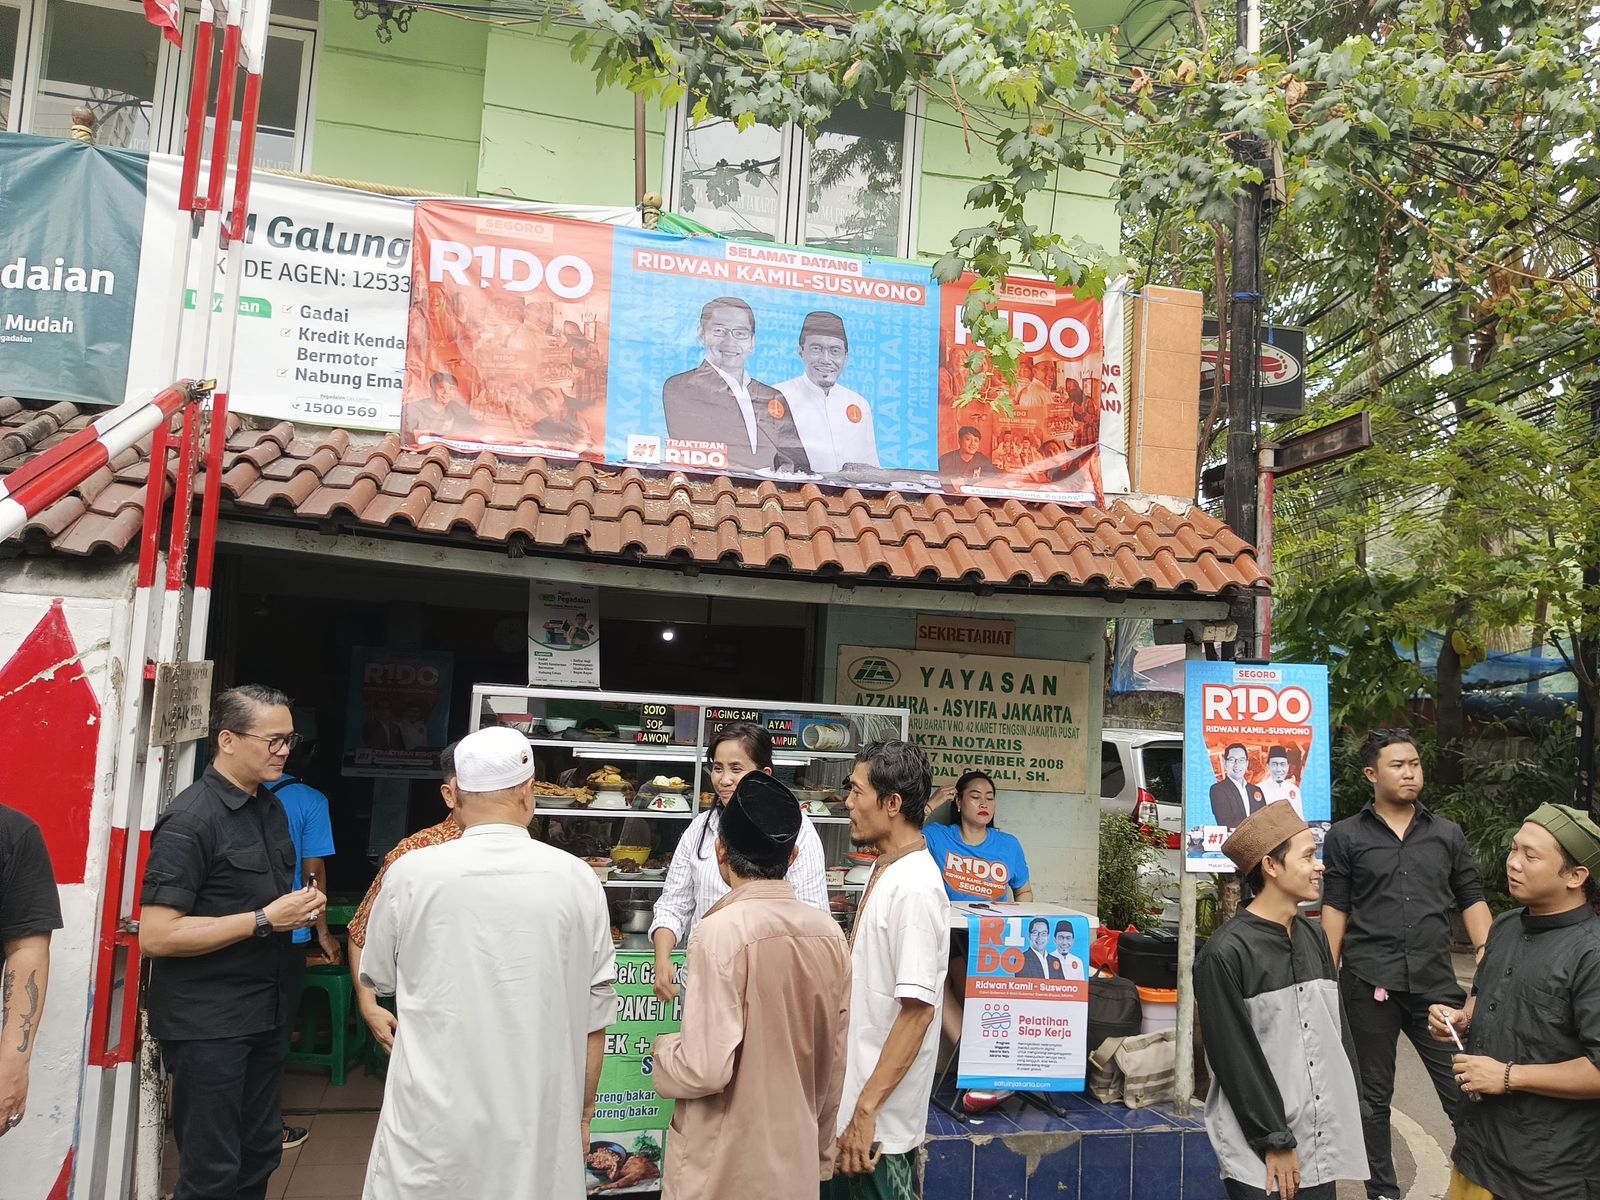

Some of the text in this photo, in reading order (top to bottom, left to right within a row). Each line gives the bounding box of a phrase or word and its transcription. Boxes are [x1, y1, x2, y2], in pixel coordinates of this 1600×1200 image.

[485, 218, 545, 235] SEGORO
[266, 215, 411, 269] Galung
[728, 245, 858, 273] SELAMAT DATANG
[1, 257, 115, 295] daian
[215, 257, 411, 293] KDE AGEN: 12533
[637, 251, 730, 278] RIDWAN
[736, 265, 922, 302] KAMIL-SUSWONO
[300, 304, 350, 323] Gadai
[5, 313, 74, 333] Mudah
[299, 326, 405, 350] Kredit Kenda
[297, 346, 379, 367] Bermotor
[295, 367, 403, 390] Nabung Ema
[304, 402, 378, 418] 1500 569
[633, 443, 657, 457] #1
[665, 439, 725, 450] TRAKTIRAN
[919, 624, 1013, 646] SEKRETARIAT
[919, 666, 1058, 696] YAYASAN
[1238, 670, 1276, 679] SEGORO
[643, 705, 666, 716] SOTO
[706, 708, 758, 721] DAGING SAPI
[942, 698, 997, 719] ASYIFA
[1002, 702, 1073, 724] JAKARTA
[646, 719, 662, 730] SOP
[714, 723, 725, 734] IG
[768, 720, 793, 730] AYAM
[908, 717, 922, 730] ARU
[924, 719, 947, 731] BARAT
[953, 721, 965, 732] NO.
[965, 721, 974, 732] 42
[975, 722, 998, 734] KARET
[999, 723, 1027, 736] TENGSIN
[1028, 725, 1057, 738] JAKARTA
[1059, 726, 1080, 739] PUSAT
[1205, 725, 1310, 736] RIDWAN KAMIL-SUSWONO
[636, 733, 669, 744] RAWON
[771, 735, 797, 746] AMPUR
[952, 736, 1022, 750] NOTARIS
[943, 753, 1025, 767] NOVEMBER
[1030, 758, 1064, 769] 2008
[932, 766, 1050, 783] DAL GZALI, SH.
[1208, 834, 1224, 844] #1
[959, 881, 993, 895] SEGORO
[978, 917, 1025, 947] R1
[977, 947, 1025, 975] DO
[975, 980, 1007, 990] Ridwan
[1009, 982, 1033, 990] Kamil
[1039, 983, 1078, 992] Suswono
[616, 995, 666, 1022] PAKET
[1019, 1015, 1069, 1026] Pelatihan
[1019, 1026, 1071, 1040] Siap Kerja
[594, 1089, 656, 1104] oreng/bakar
